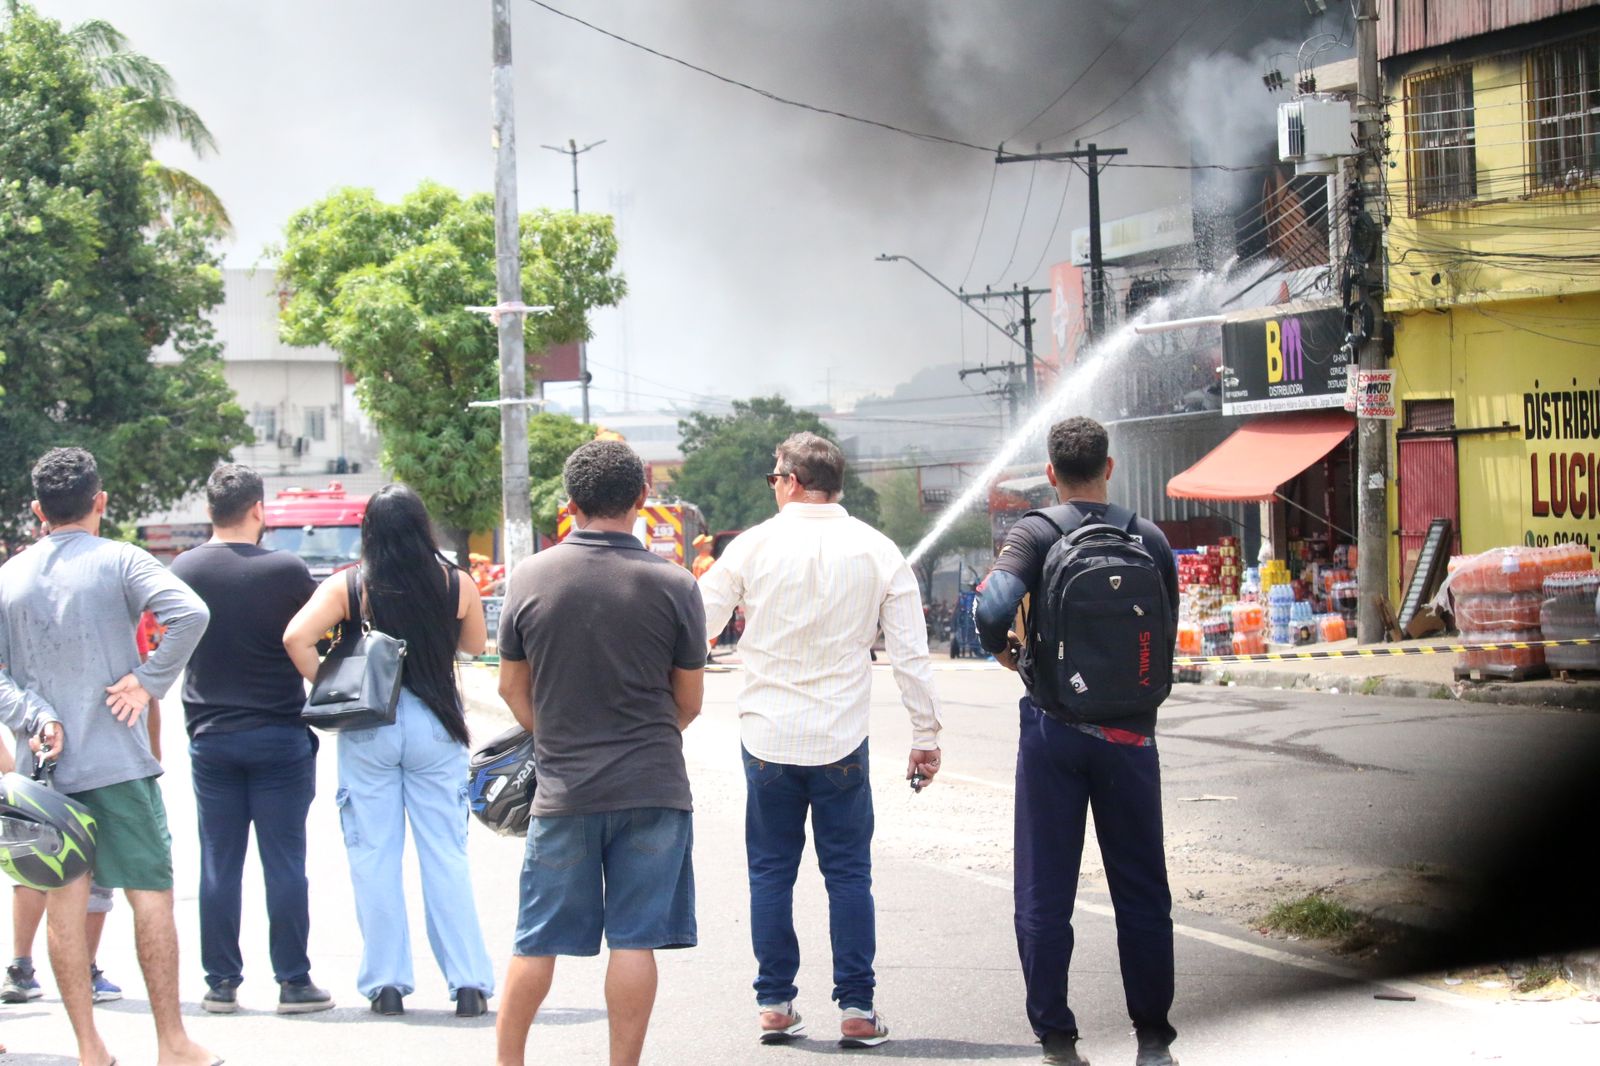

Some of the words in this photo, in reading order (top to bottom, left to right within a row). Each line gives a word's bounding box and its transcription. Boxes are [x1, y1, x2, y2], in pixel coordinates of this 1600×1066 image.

[1265, 317, 1304, 384] BM
[1268, 384, 1304, 397] DISTRIBUIDORA
[1366, 382, 1391, 395] MOTO
[1366, 394, 1389, 403] ZERO
[1530, 452, 1600, 520] LUCI
[653, 525, 675, 537] 193
[1139, 631, 1151, 687] SHMILY
